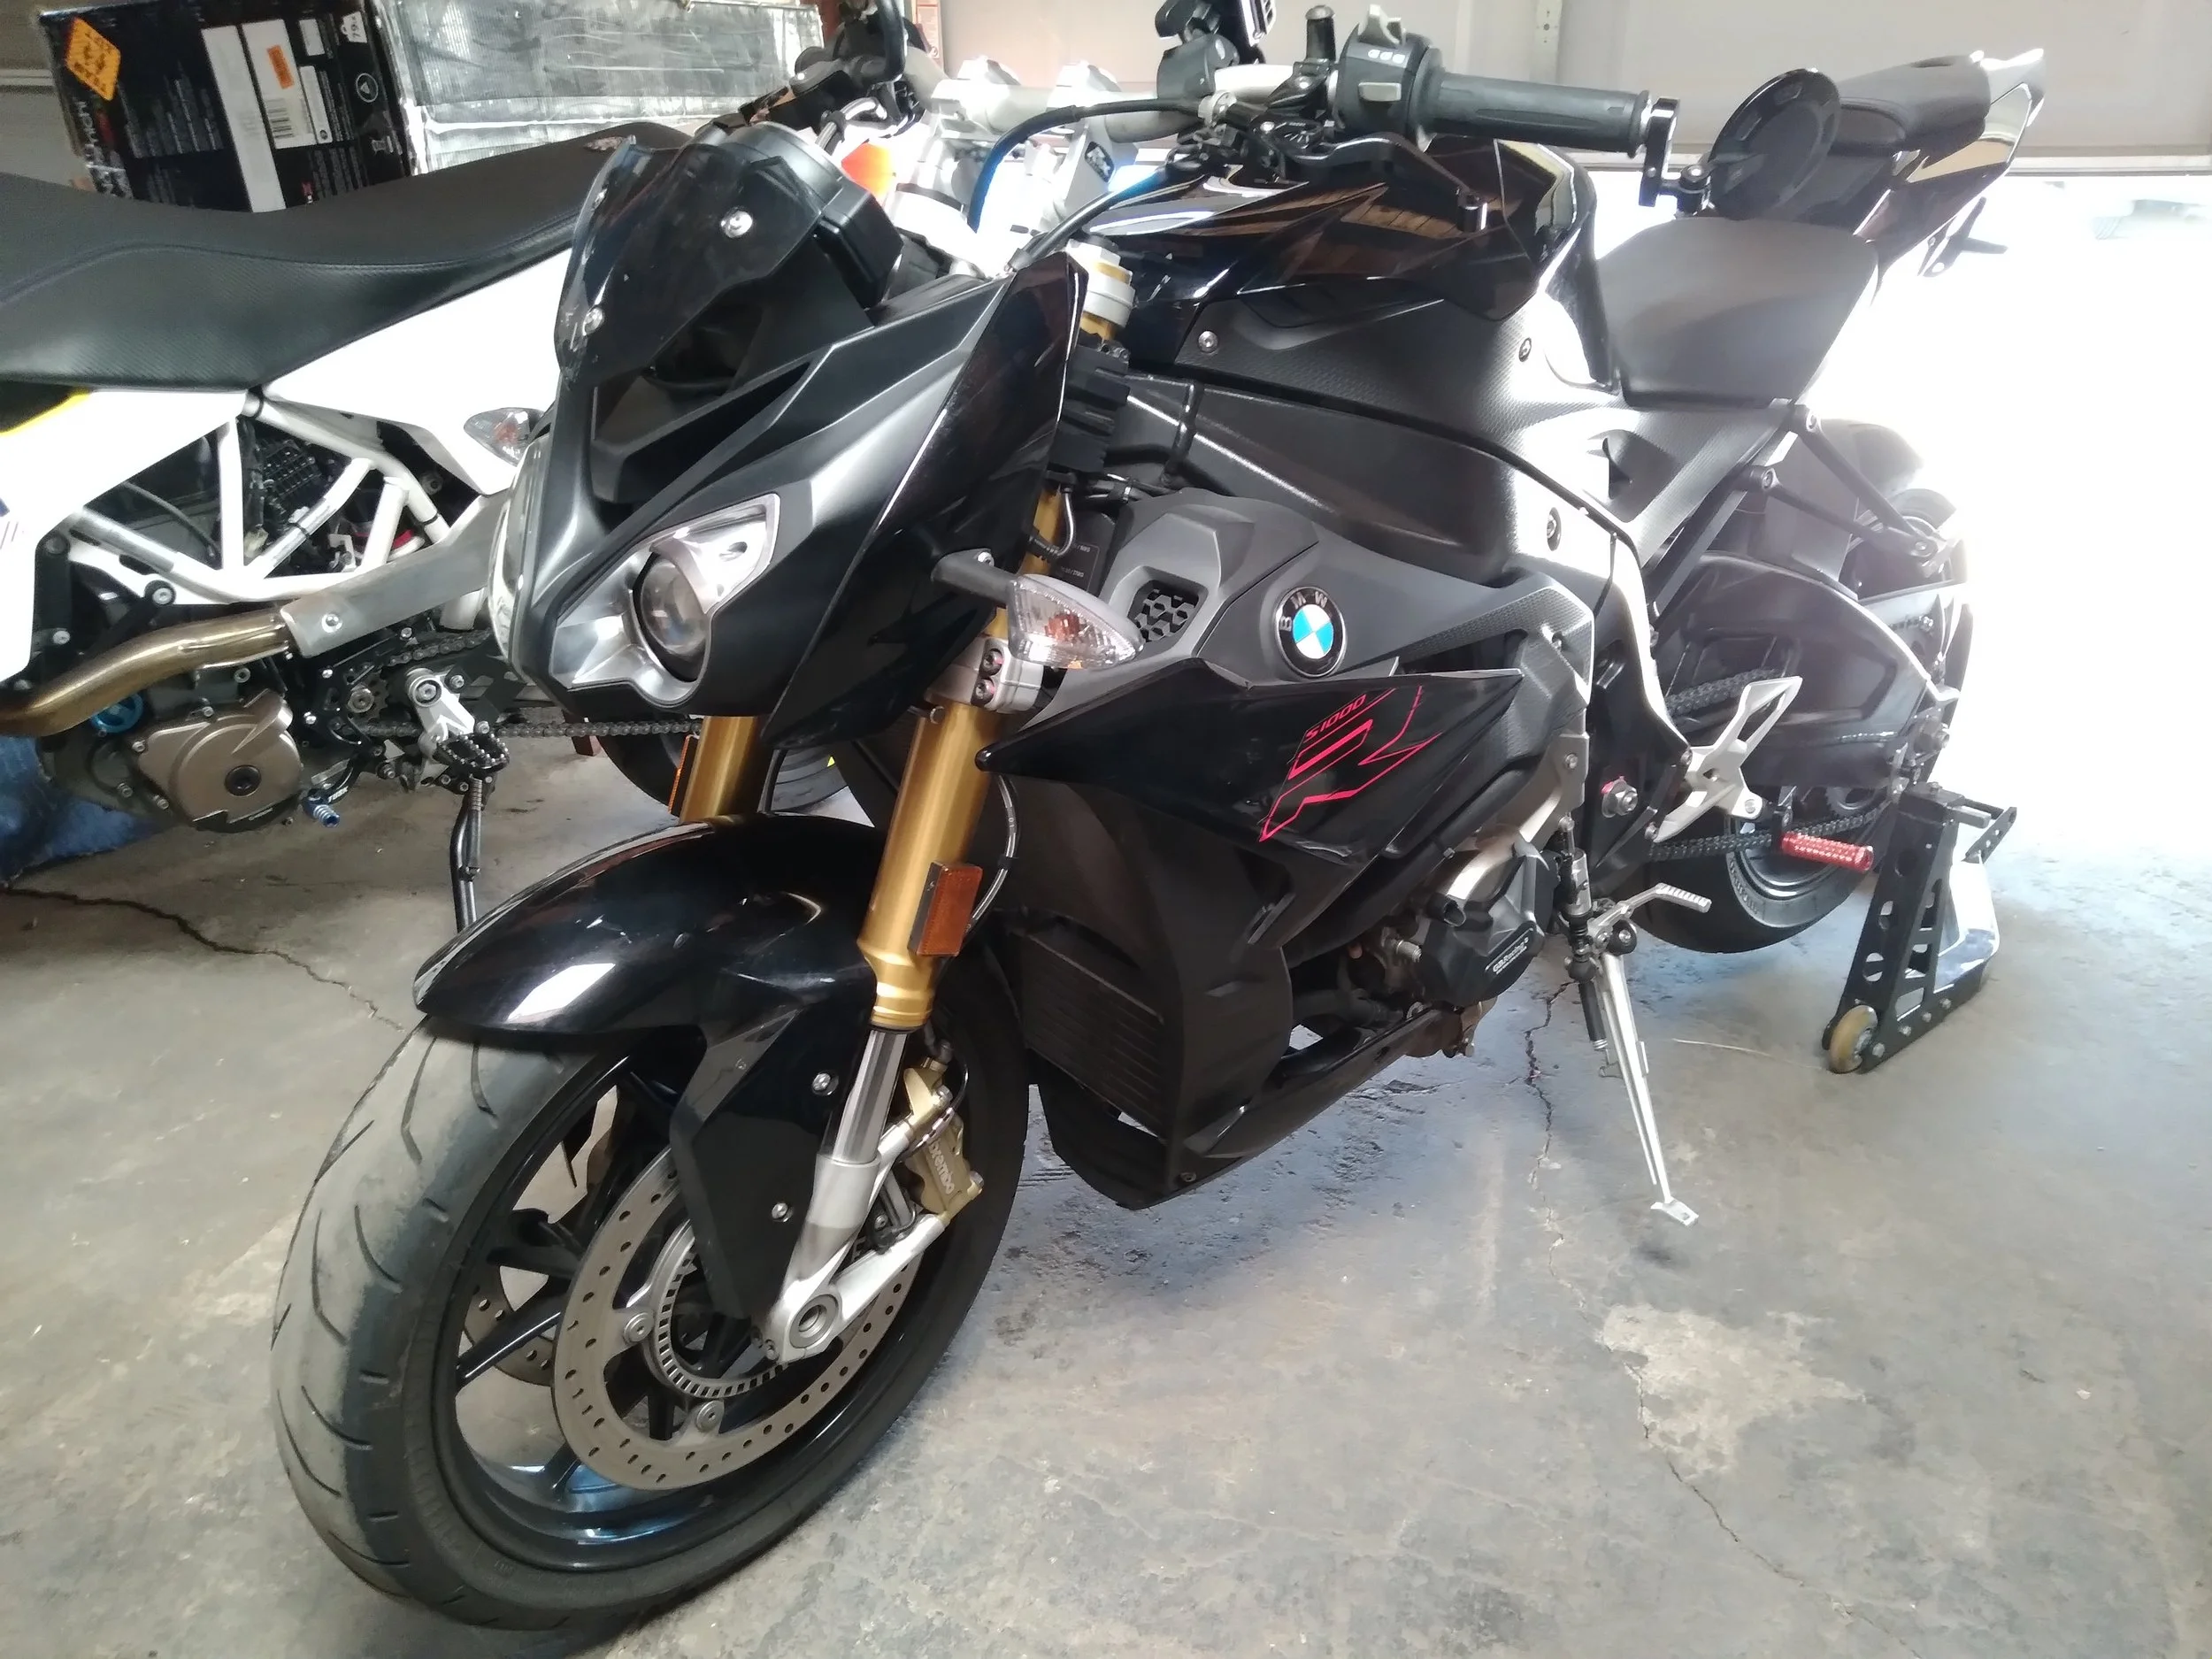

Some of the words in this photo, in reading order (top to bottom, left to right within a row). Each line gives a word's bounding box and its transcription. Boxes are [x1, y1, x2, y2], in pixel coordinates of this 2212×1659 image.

[1279, 590, 1329, 632] BMW
[1304, 694, 1367, 741] S1000
[928, 1138, 955, 1194] brembo
